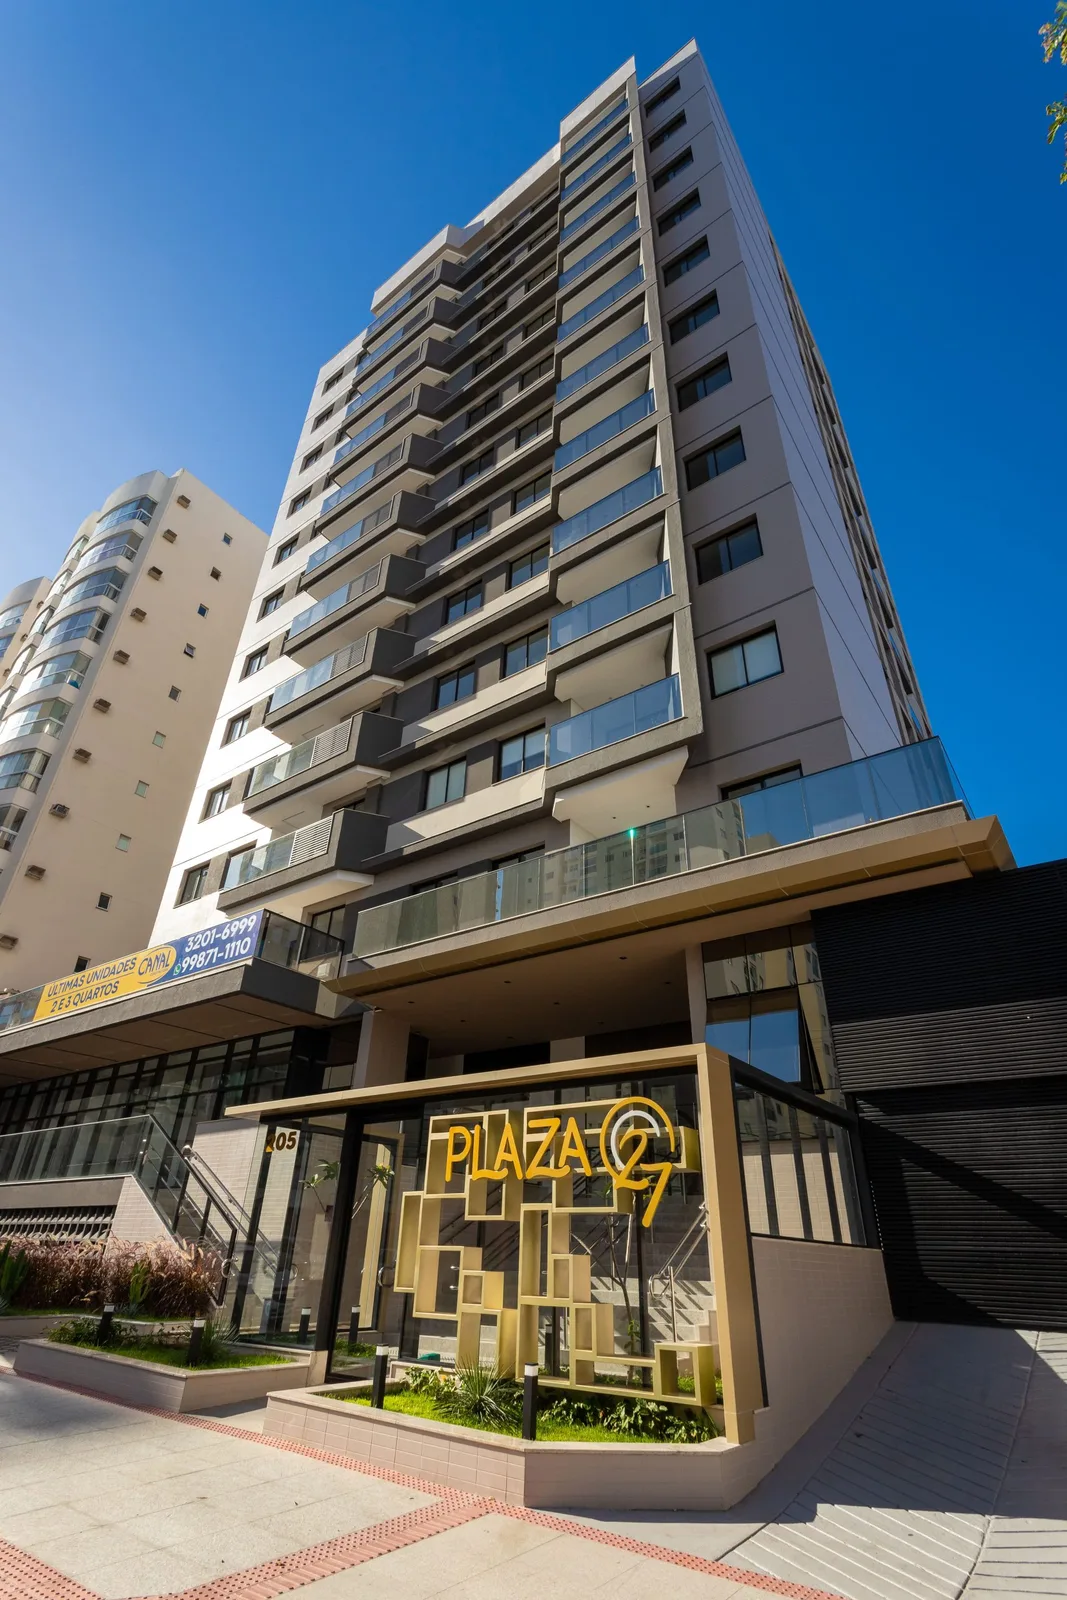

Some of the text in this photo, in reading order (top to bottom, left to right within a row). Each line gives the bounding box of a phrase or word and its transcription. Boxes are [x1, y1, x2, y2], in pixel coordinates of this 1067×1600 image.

[185, 915, 257, 953] 3201-6999
[86, 957, 137, 985] UNIDADES
[138, 950, 171, 976] CANAL
[181, 937, 251, 973] 99871-1110
[50, 981, 120, 1013] 2 E 3 QUARTOS
[265, 1131, 297, 1152] 205
[445, 1116, 592, 1182] PLAZA
